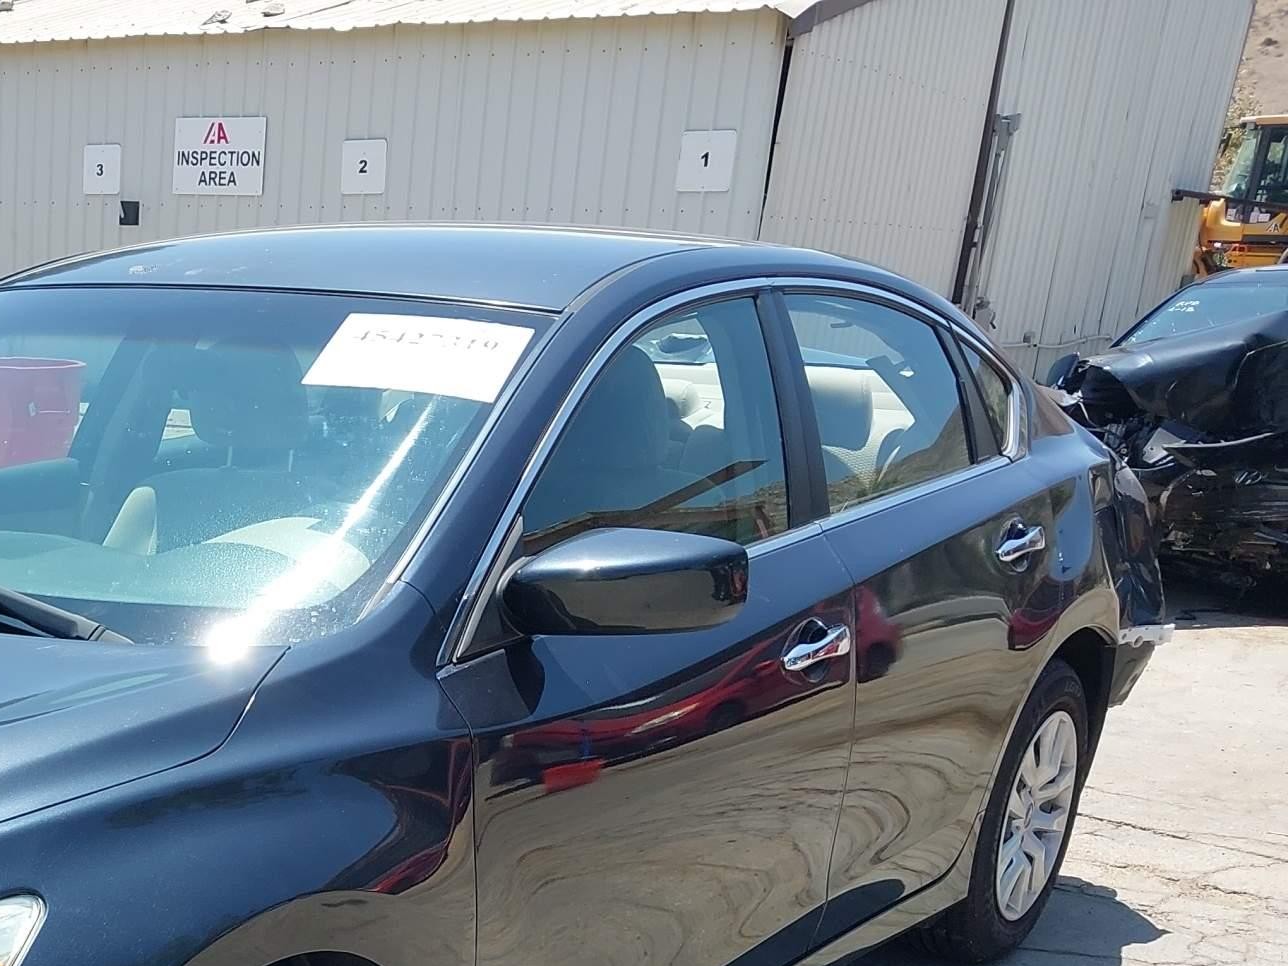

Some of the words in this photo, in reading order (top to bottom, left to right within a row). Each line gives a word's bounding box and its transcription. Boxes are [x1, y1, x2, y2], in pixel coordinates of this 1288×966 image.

[177, 150, 261, 167] INSPECTION
[358, 159, 368, 174] 2
[701, 151, 710, 168] 1
[96, 163, 104, 177] 3
[198, 170, 237, 187] AREA
